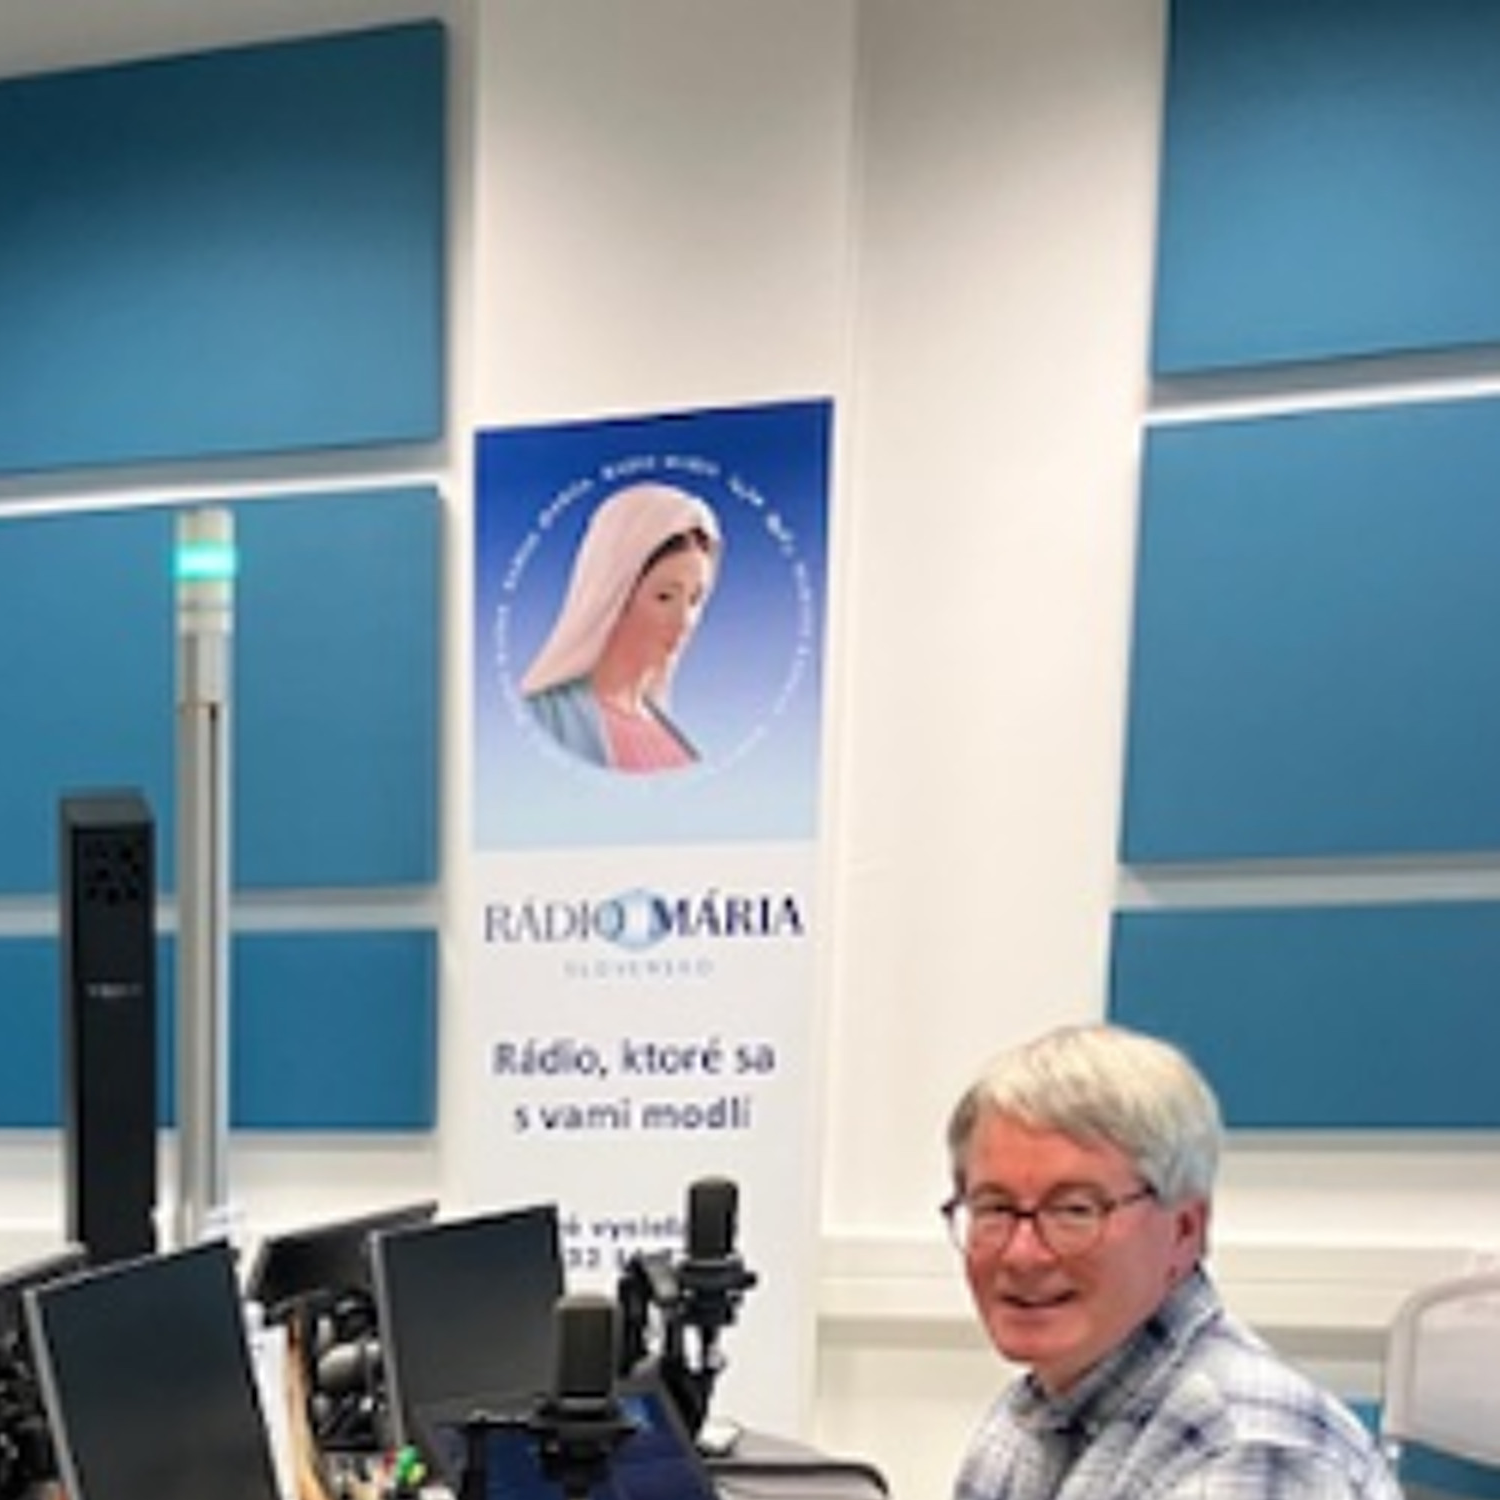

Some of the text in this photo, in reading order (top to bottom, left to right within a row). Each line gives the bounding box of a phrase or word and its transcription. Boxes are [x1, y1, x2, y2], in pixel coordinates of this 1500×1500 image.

[484, 887, 805, 943] RÁDIO MÁRIA
[494, 1037, 775, 1078] Rádio, ktoré sa
[514, 1105, 530, 1132] s
[539, 1098, 632, 1130] vami
